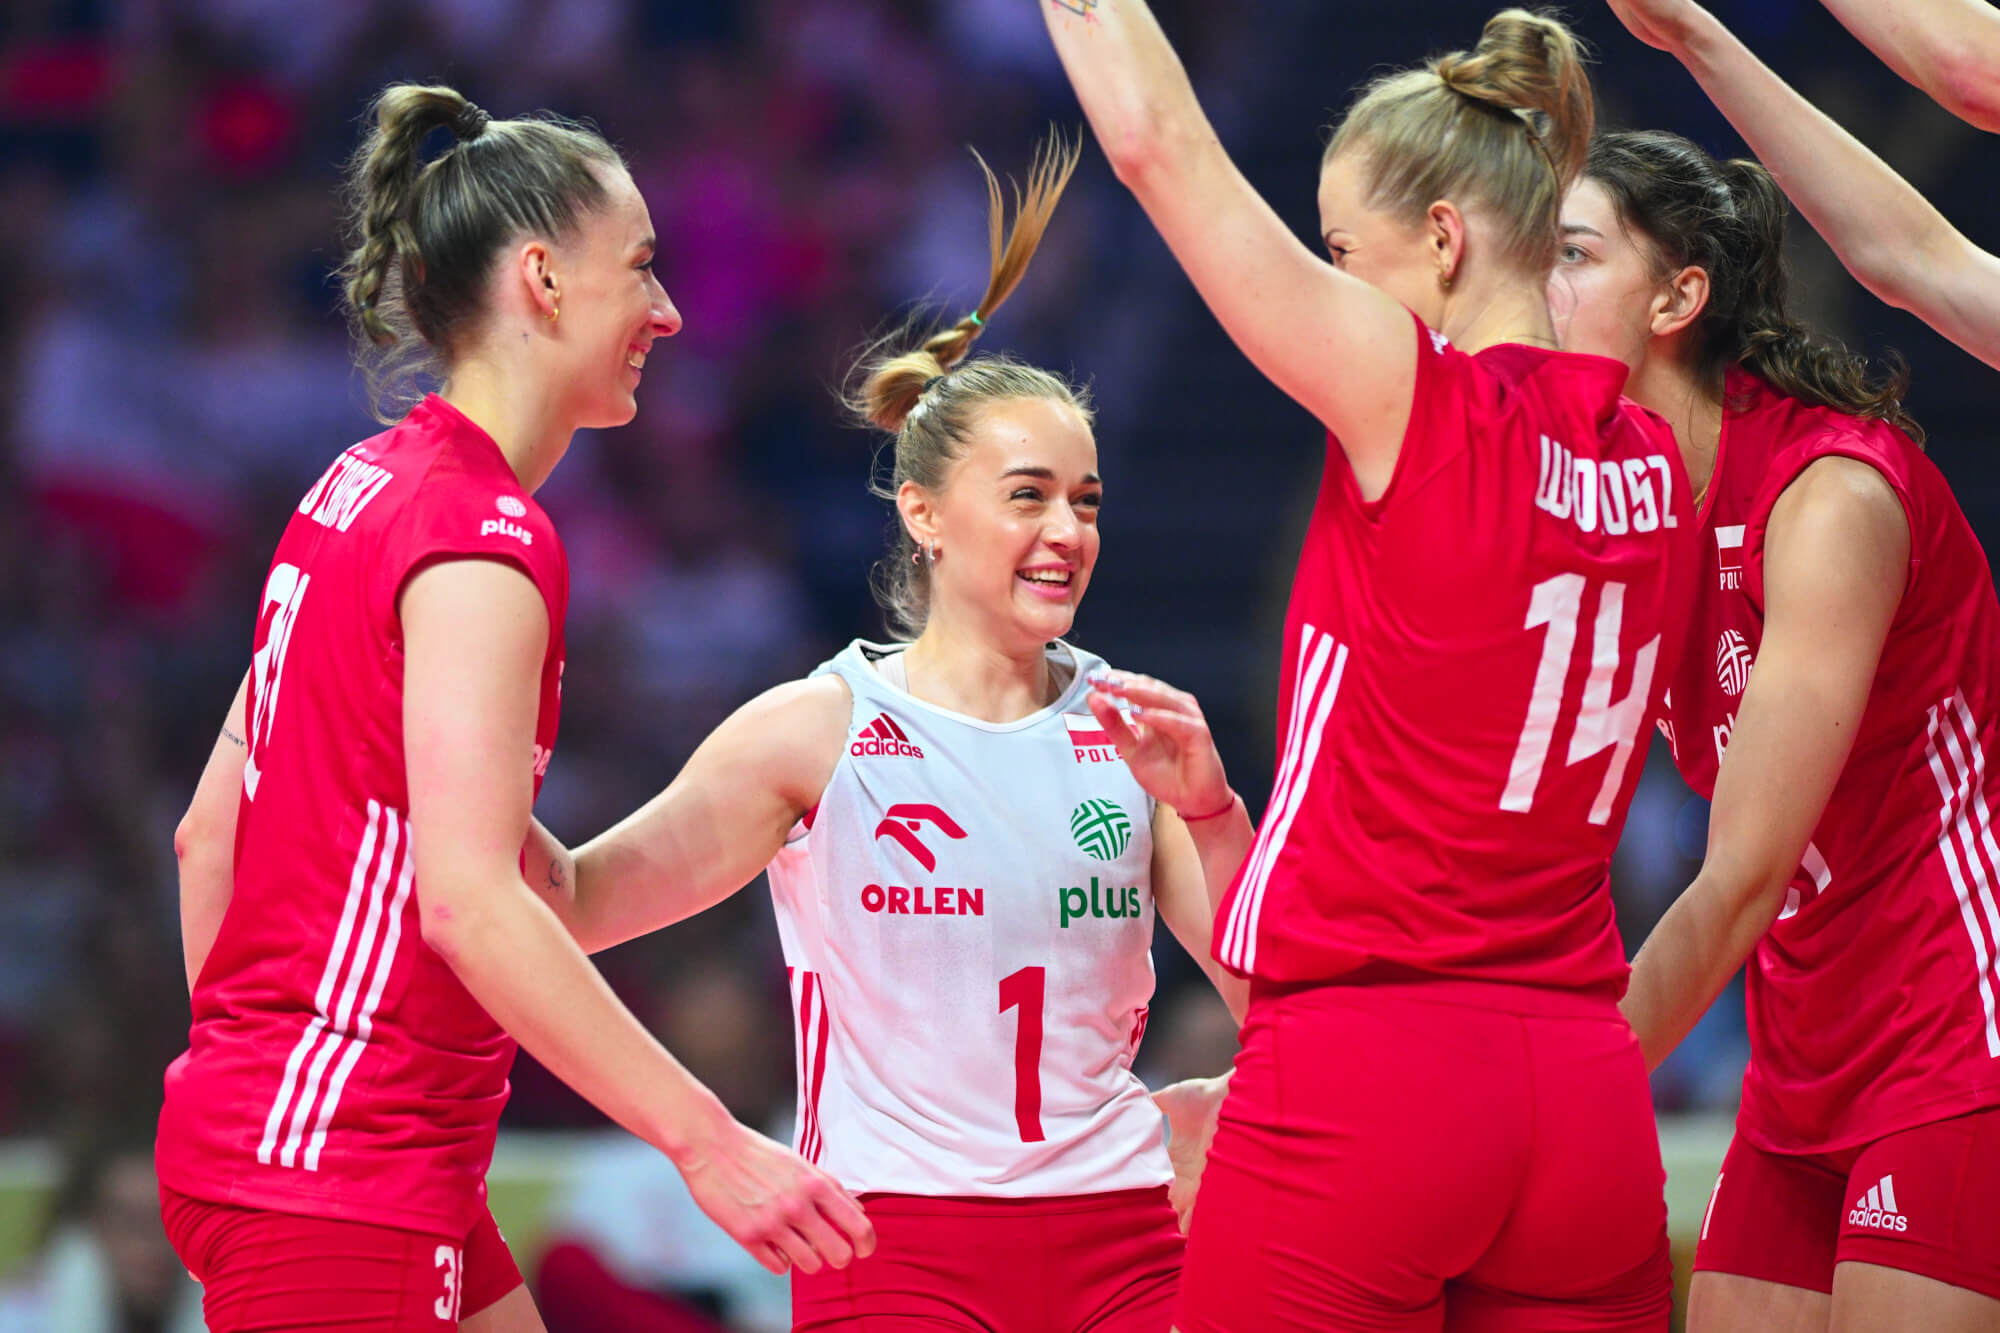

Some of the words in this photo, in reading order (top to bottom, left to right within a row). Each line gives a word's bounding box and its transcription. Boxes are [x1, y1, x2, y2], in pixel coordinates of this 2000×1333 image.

[1535, 434, 1678, 536] WOOSZ
[481, 517, 533, 545] plus
[1498, 572, 1662, 826] 14
[850, 737, 924, 760] adidas
[861, 884, 985, 916] ORLEN
[1059, 877, 1141, 928] plus
[998, 966, 1047, 1143] 1
[1848, 1206, 1908, 1233] adidas
